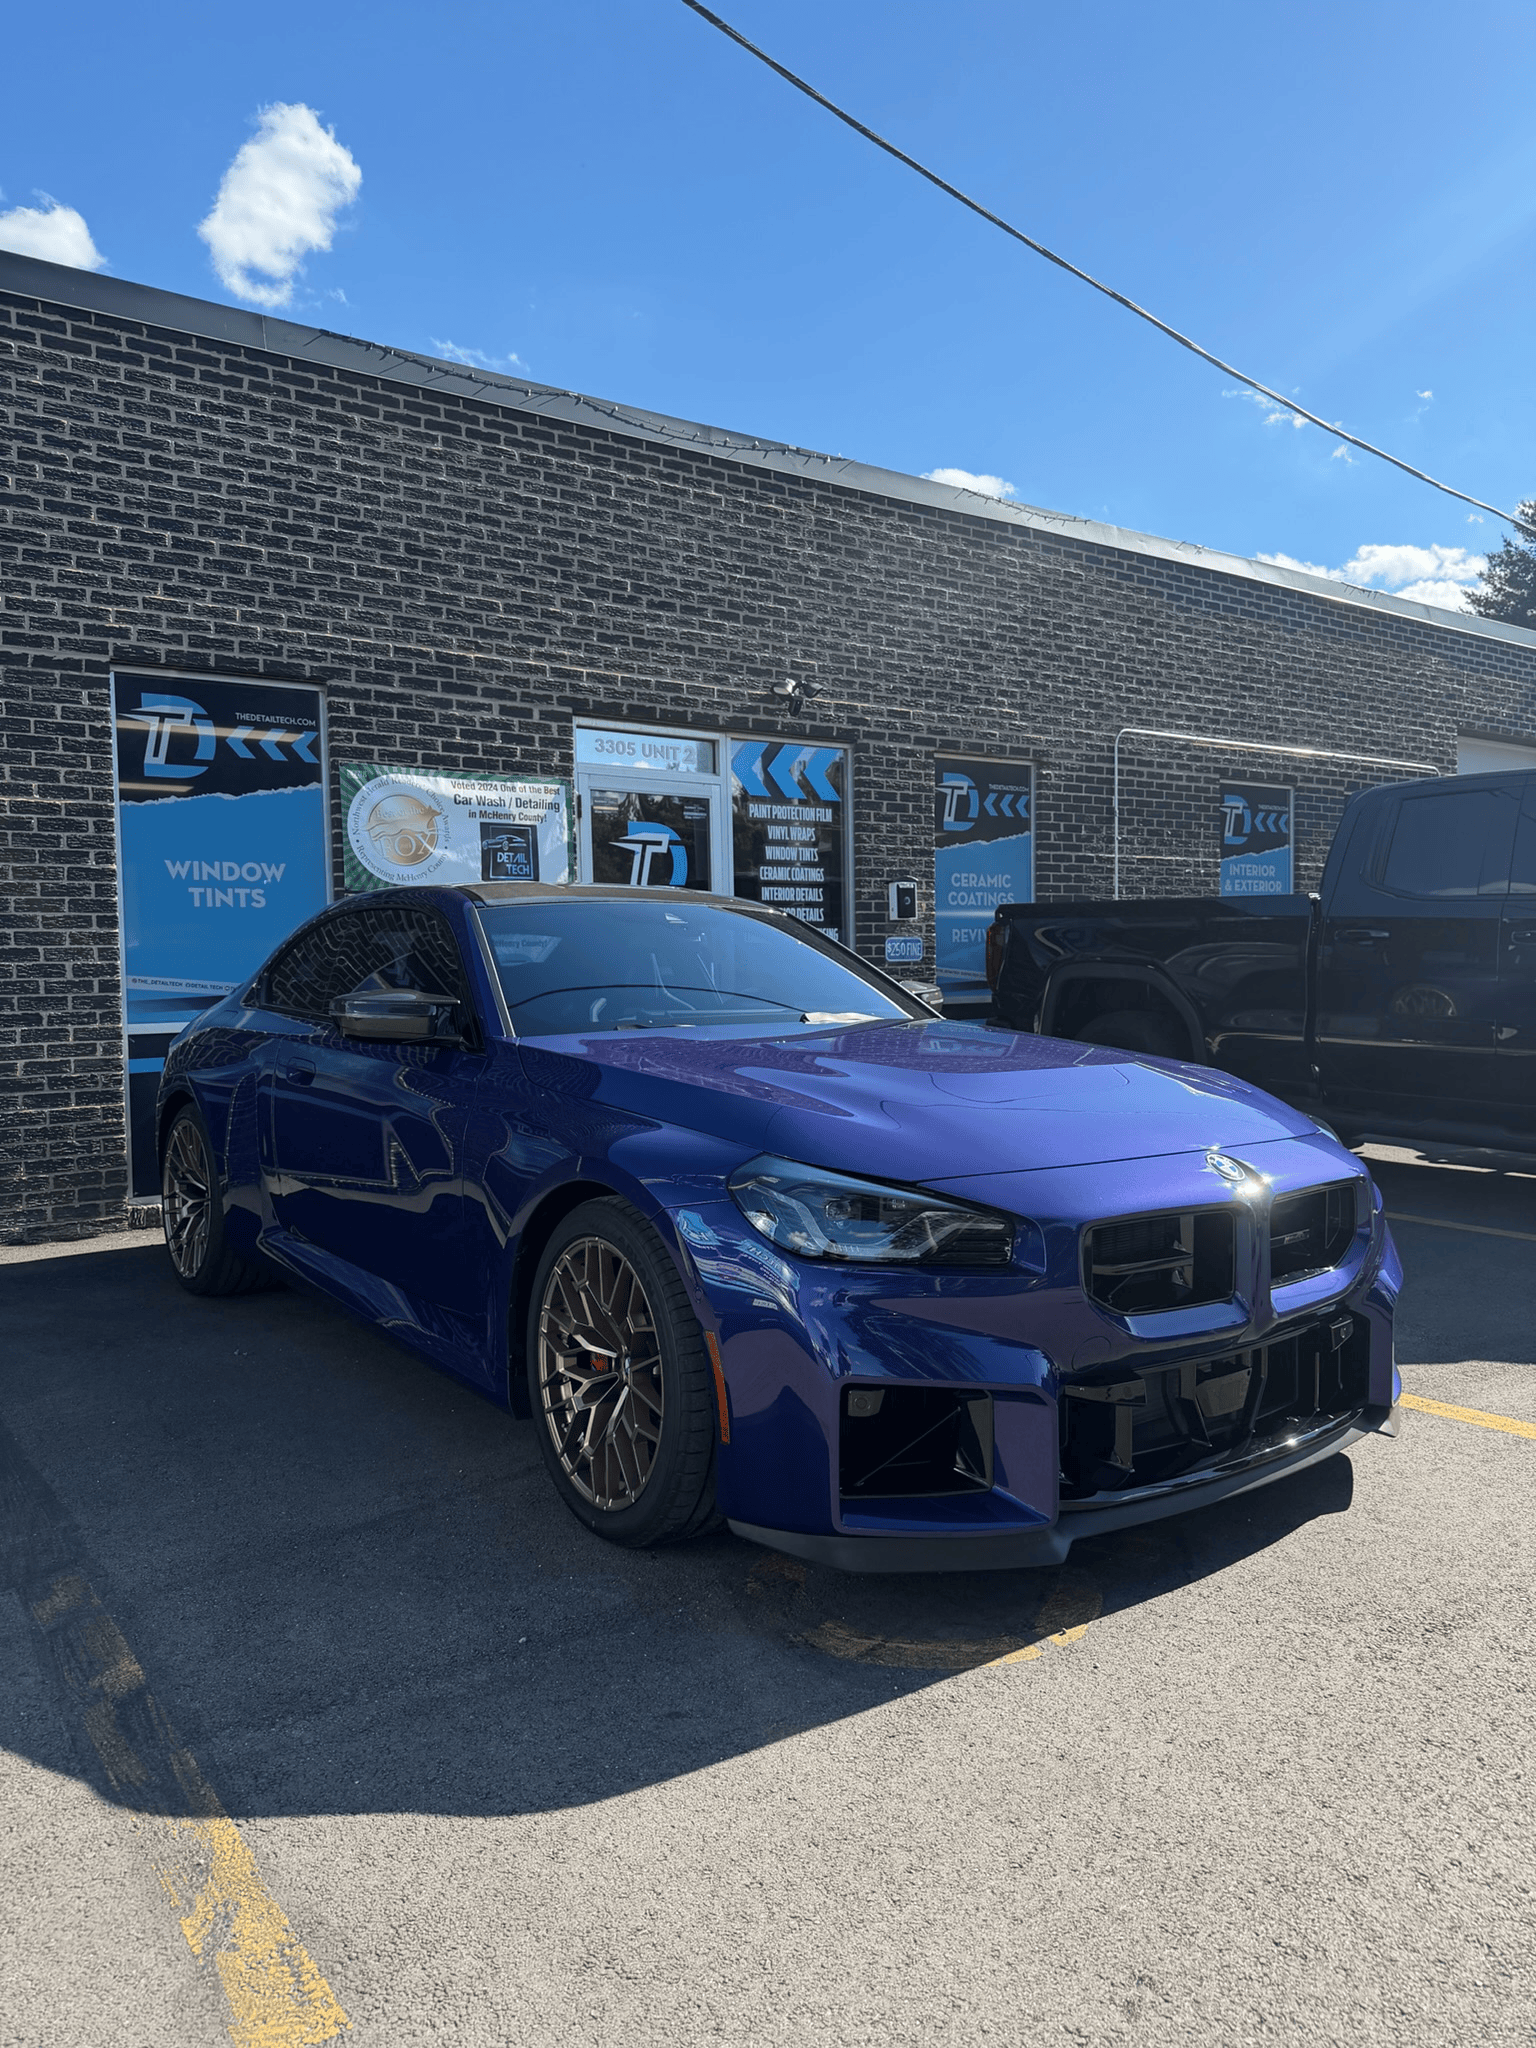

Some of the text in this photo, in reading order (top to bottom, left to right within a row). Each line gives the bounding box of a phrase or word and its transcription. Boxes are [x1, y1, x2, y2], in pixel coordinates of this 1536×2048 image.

[235, 712, 316, 727] THEDETAILTECH.COM
[594, 738, 696, 765] 3305 UNIT 2
[450, 780, 560, 796] Voted 2024 One of the Best
[352, 795, 367, 836] Northwest
[365, 779, 390, 797] Herald
[453, 793, 560, 813] Car Wash / Detailing
[468, 809, 547, 824] in McHenry County!
[749, 803, 832, 823] PAINT PROTECTION FILM
[767, 825, 816, 842] VINYL WRAPS
[496, 852, 528, 864] DETAIL
[765, 846, 819, 862] WINDOW TINTS
[164, 860, 286, 883] WINDOW
[356, 845, 395, 881] Representing
[396, 871, 428, 882] McHenry
[505, 863, 530, 875] TECH
[1229, 863, 1276, 878] INTERIOR
[760, 866, 825, 882] CERAMIC COATINGS
[951, 872, 1012, 889] CERAMIC
[761, 886, 824, 902] INTERIOR DETAILS
[1224, 879, 1283, 893] & EXTERIOR
[188, 887, 267, 909] TINTS
[947, 891, 1014, 907] COATINGS
[797, 908, 824, 922] DETAILS
[887, 942, 921, 957] $250 FINE
